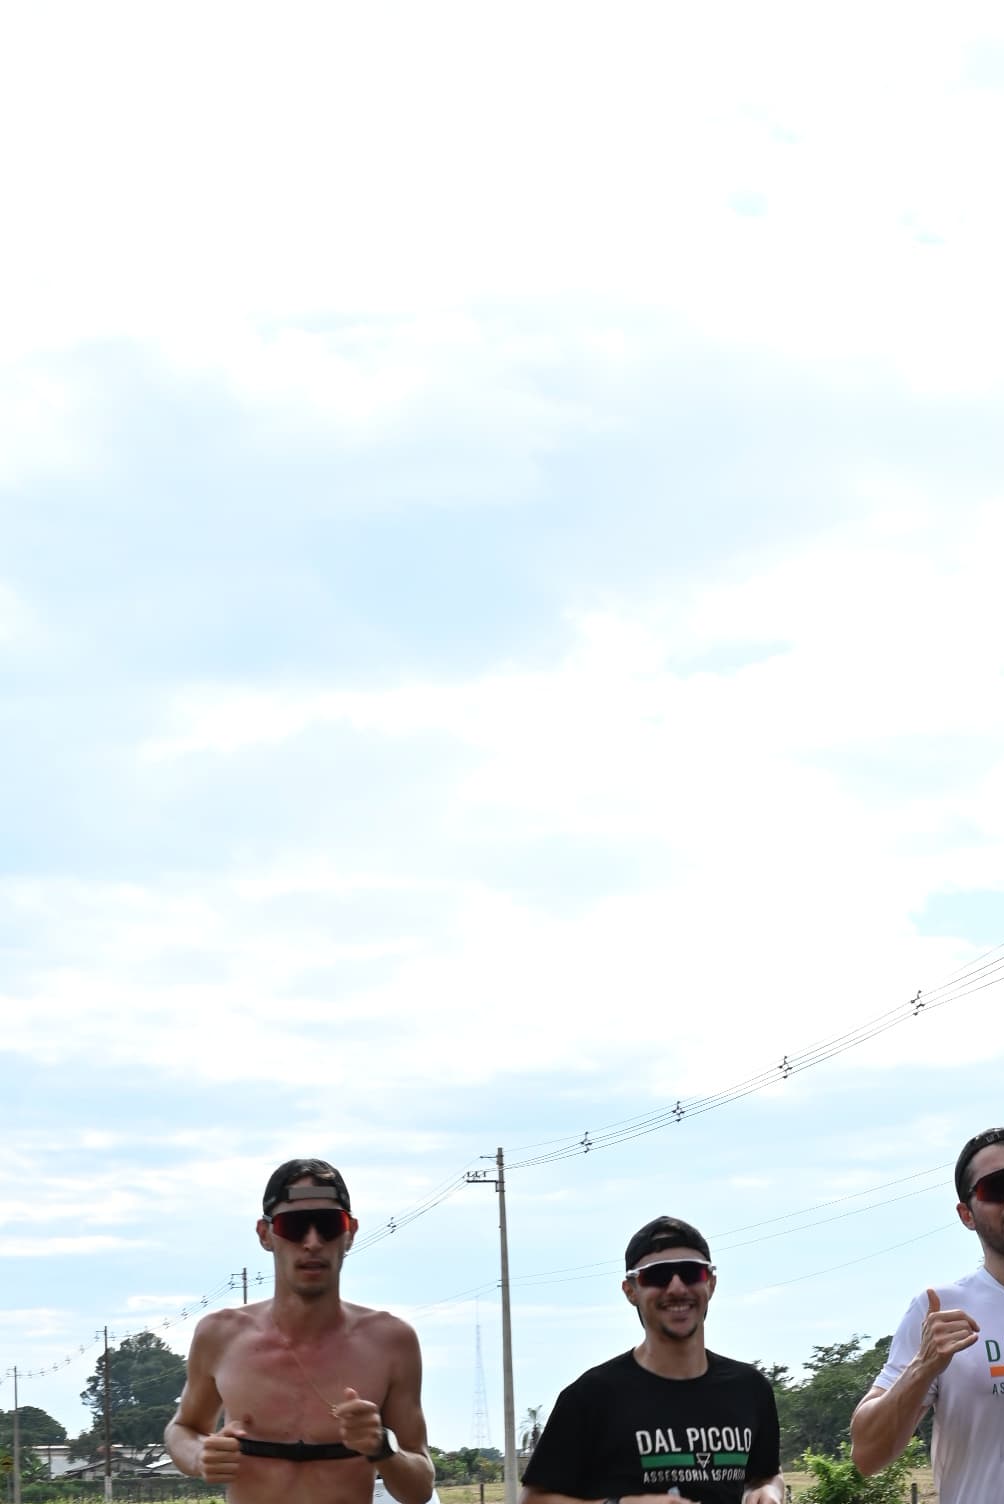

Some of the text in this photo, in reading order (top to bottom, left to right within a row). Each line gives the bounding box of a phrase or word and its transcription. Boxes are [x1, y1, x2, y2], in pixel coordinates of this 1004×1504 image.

[636, 1427, 752, 1455] DAL PICOLO
[643, 1468, 709, 1484] ASSESSORIA
